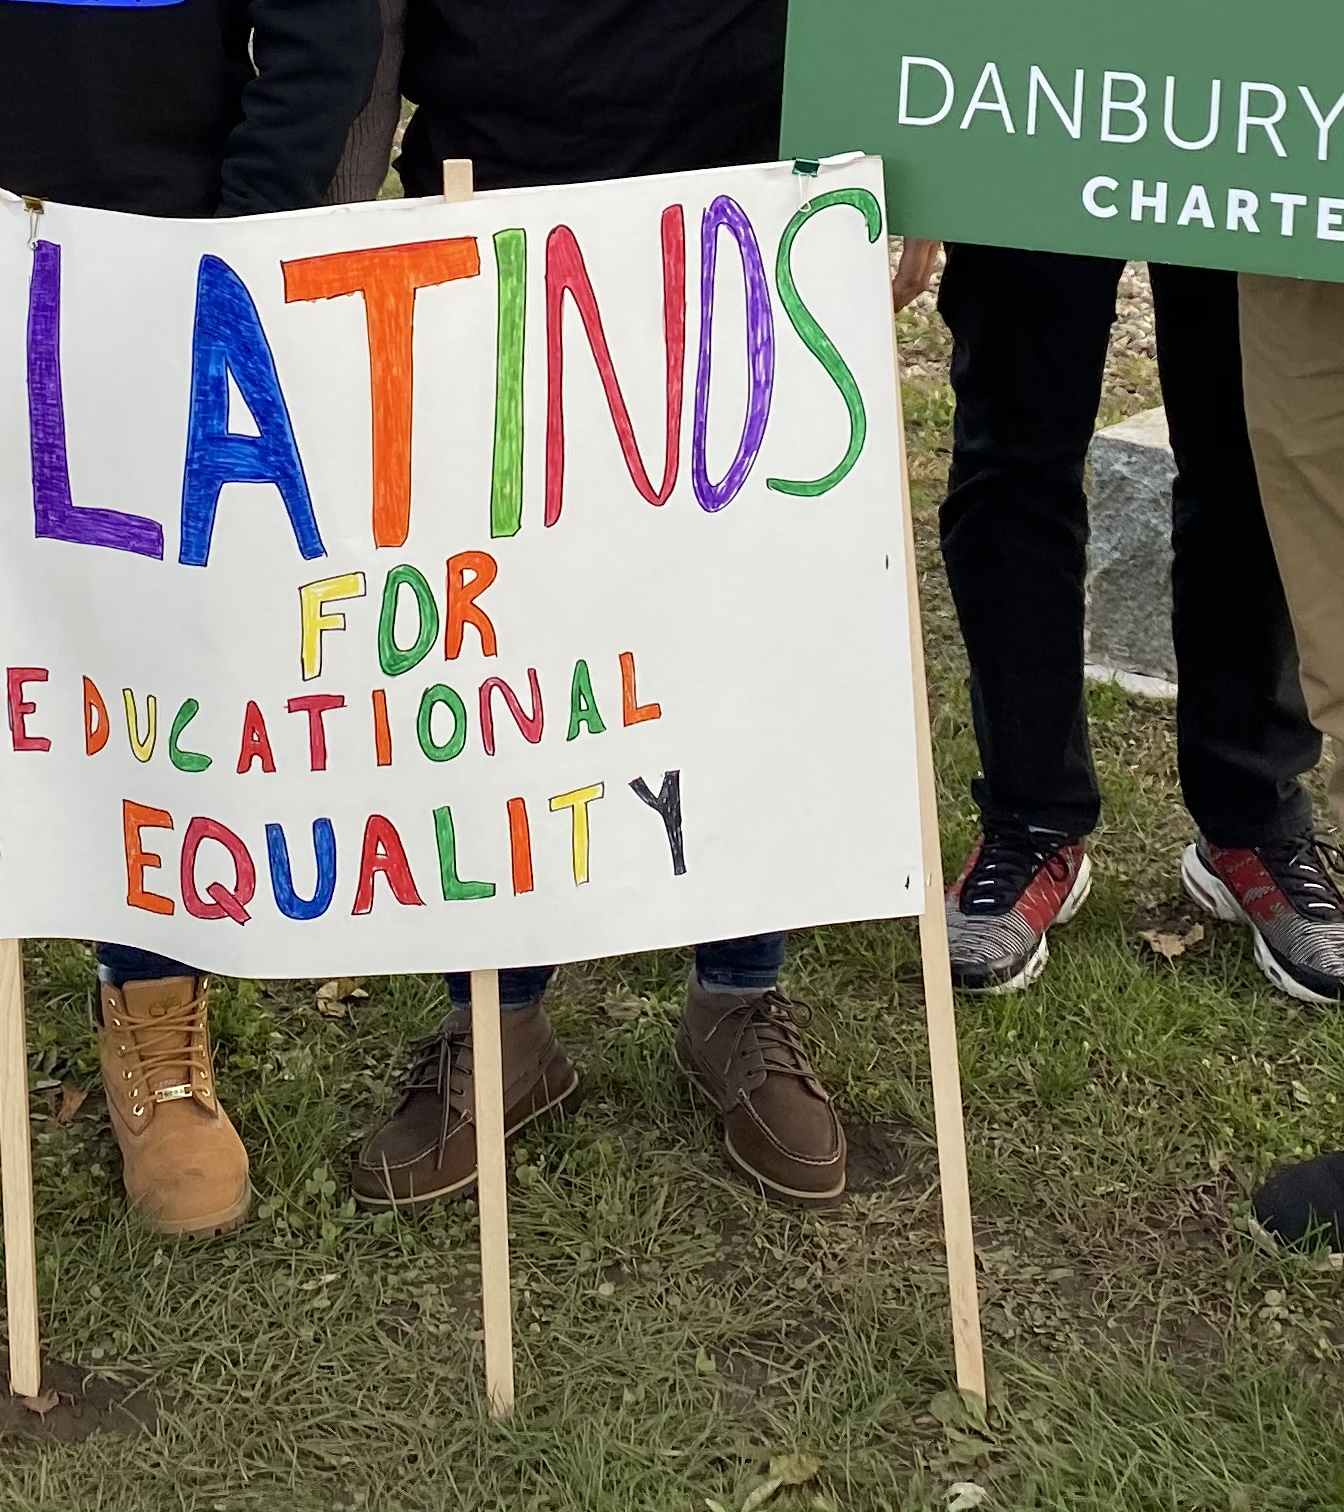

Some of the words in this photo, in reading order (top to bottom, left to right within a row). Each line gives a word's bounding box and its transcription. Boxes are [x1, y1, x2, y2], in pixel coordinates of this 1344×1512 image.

[26, 187, 883, 566] LATINOS
[300, 550, 497, 681] FOR
[6, 652, 662, 775] EDUCATIONAL
[122, 770, 687, 925] EQUALITY
